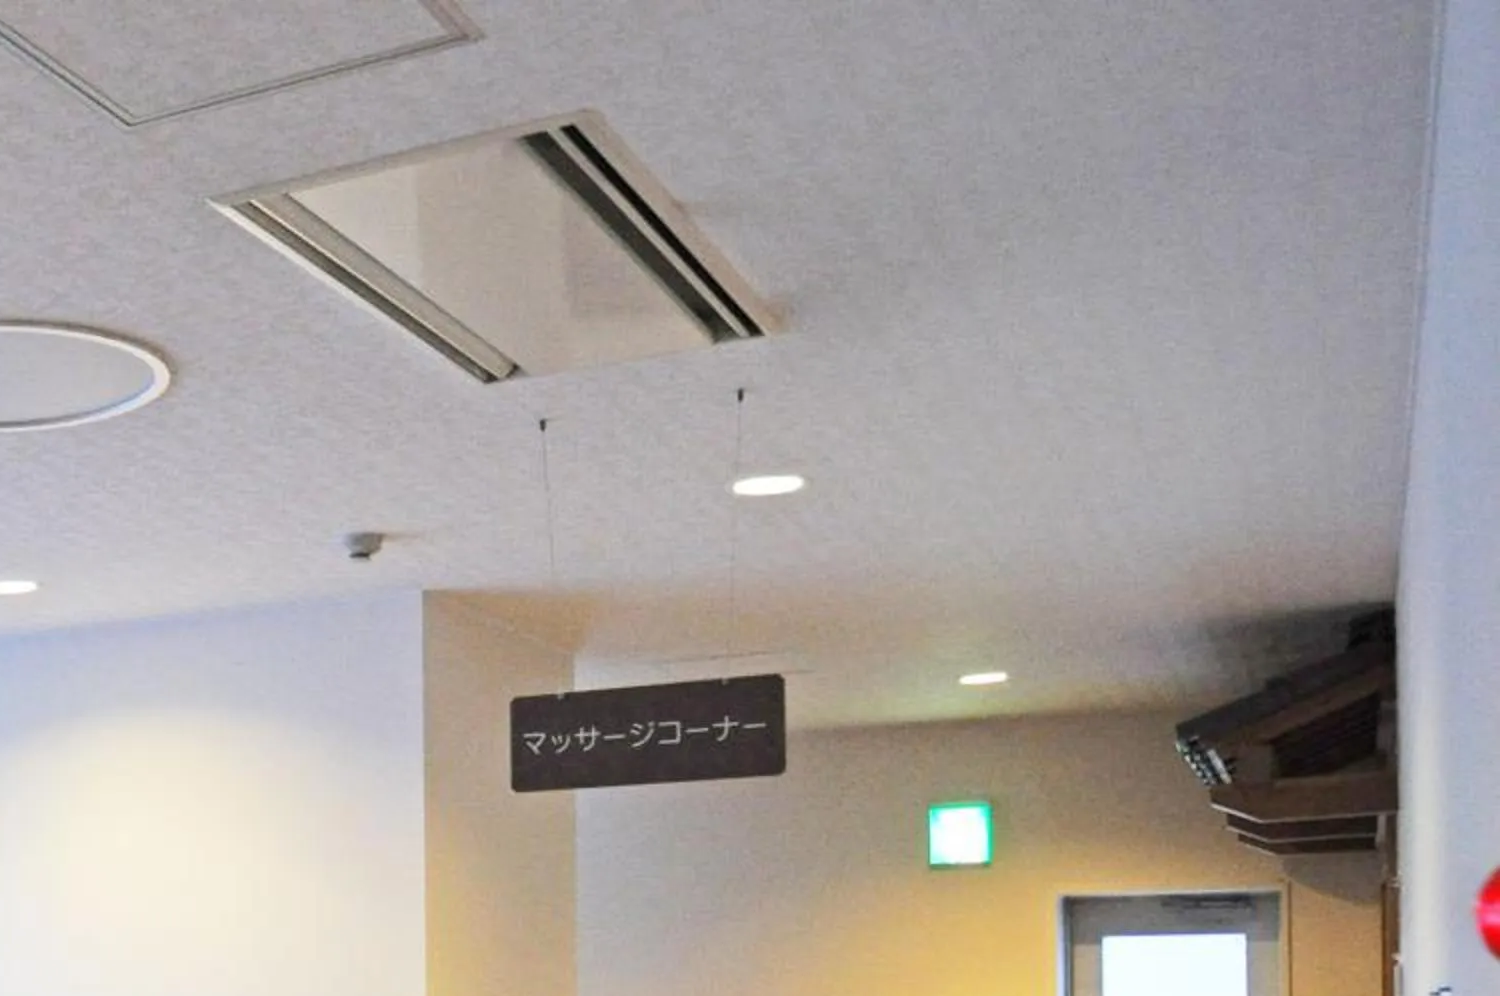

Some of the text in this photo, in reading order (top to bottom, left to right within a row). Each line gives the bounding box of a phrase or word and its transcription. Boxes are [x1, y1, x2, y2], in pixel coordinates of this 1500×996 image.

[522, 715, 768, 755] マッサージコーナー
